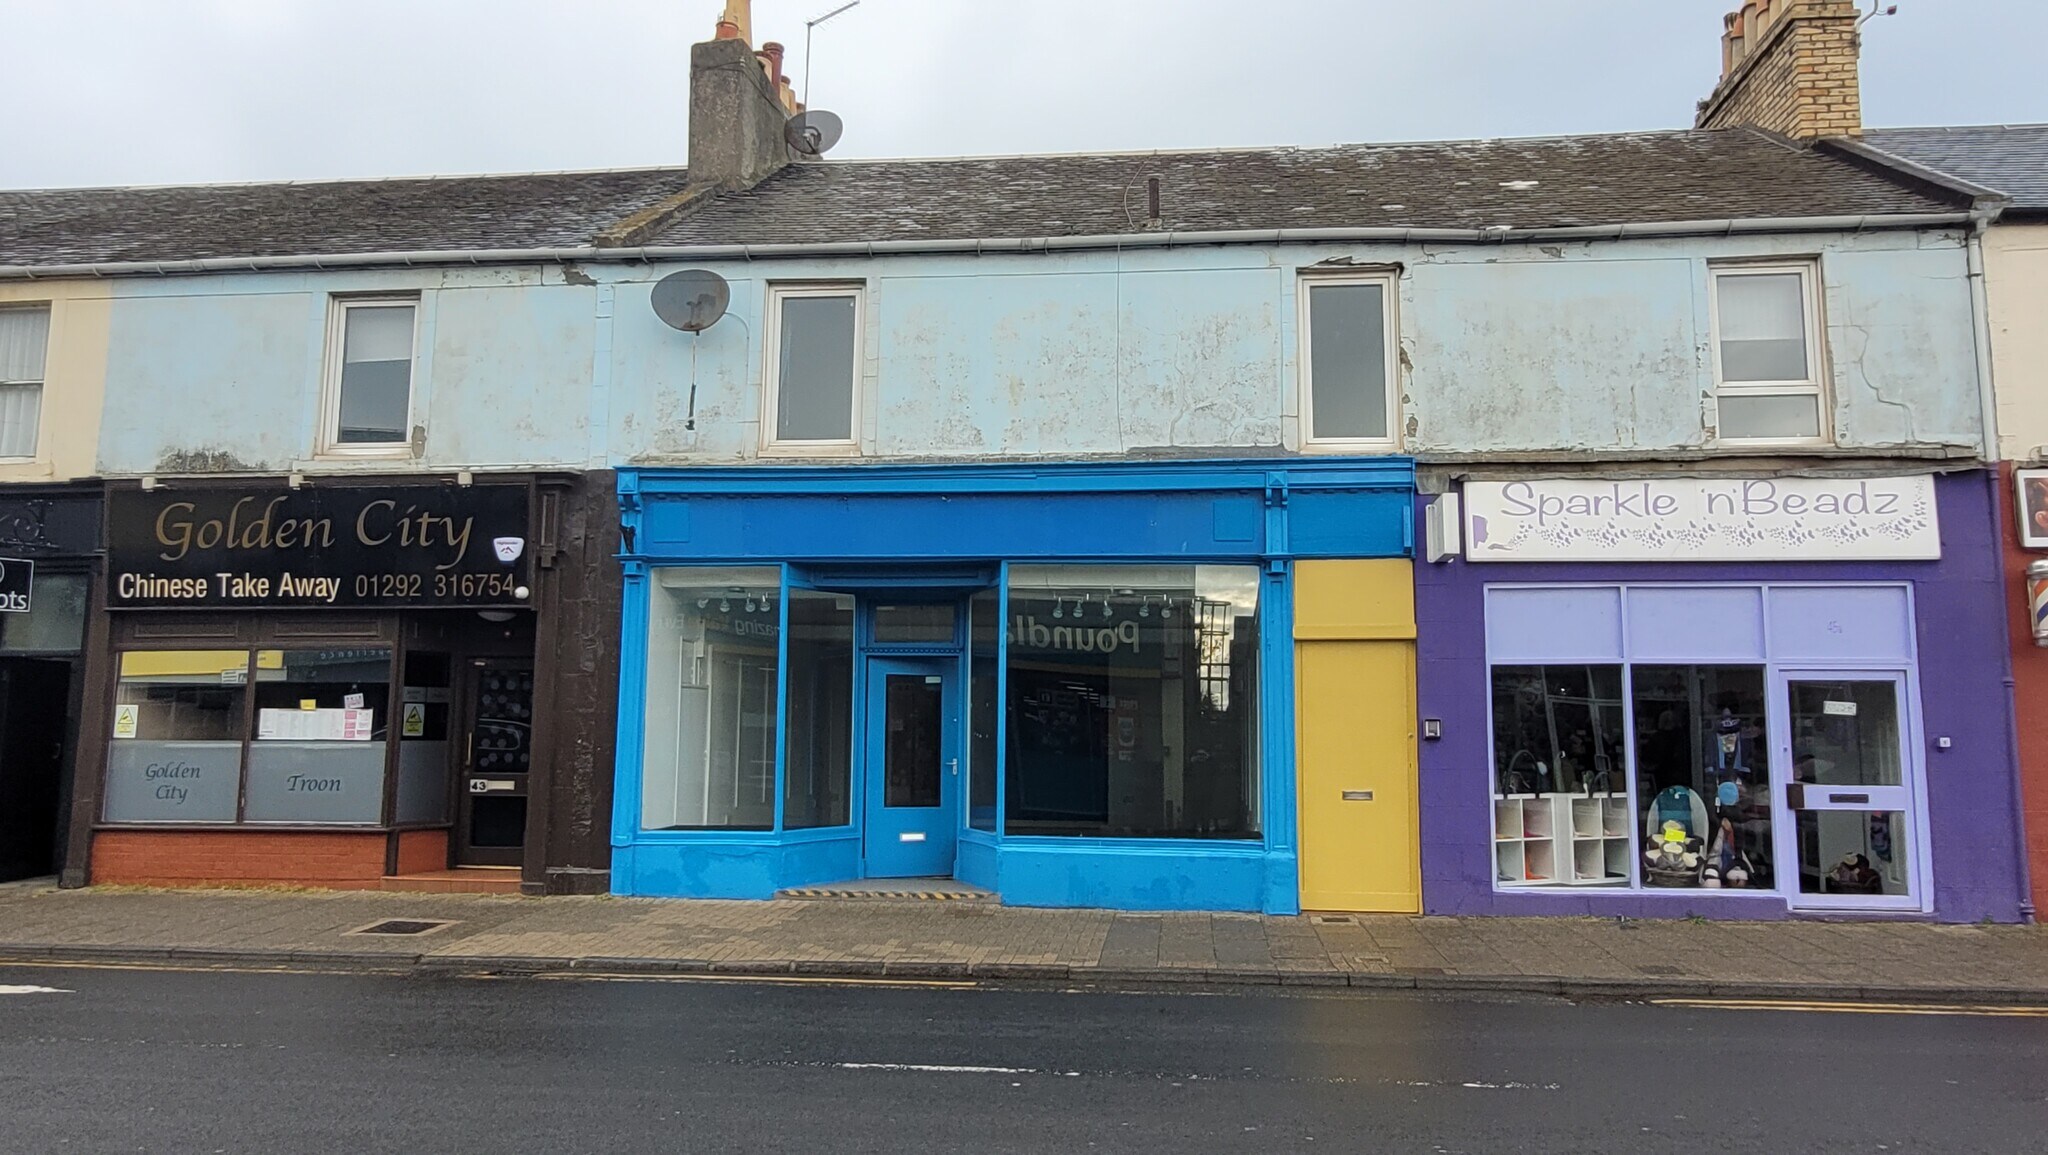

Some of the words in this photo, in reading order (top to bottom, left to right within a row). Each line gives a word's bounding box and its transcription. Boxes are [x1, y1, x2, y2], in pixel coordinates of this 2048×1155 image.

[1501, 482, 1679, 527] Sparkle
[156, 495, 335, 561] Golden
[356, 499, 474, 570] City
[119, 572, 208, 599] Chinese
[216, 572, 270, 598] Take
[277, 572, 341, 602] Away
[355, 573, 422, 597] 01292
[434, 573, 515, 597] 316754
[145, 761, 200, 781] Golden
[287, 774, 342, 792] Troon
[471, 782, 487, 791] 43
[156, 784, 188, 804] City
